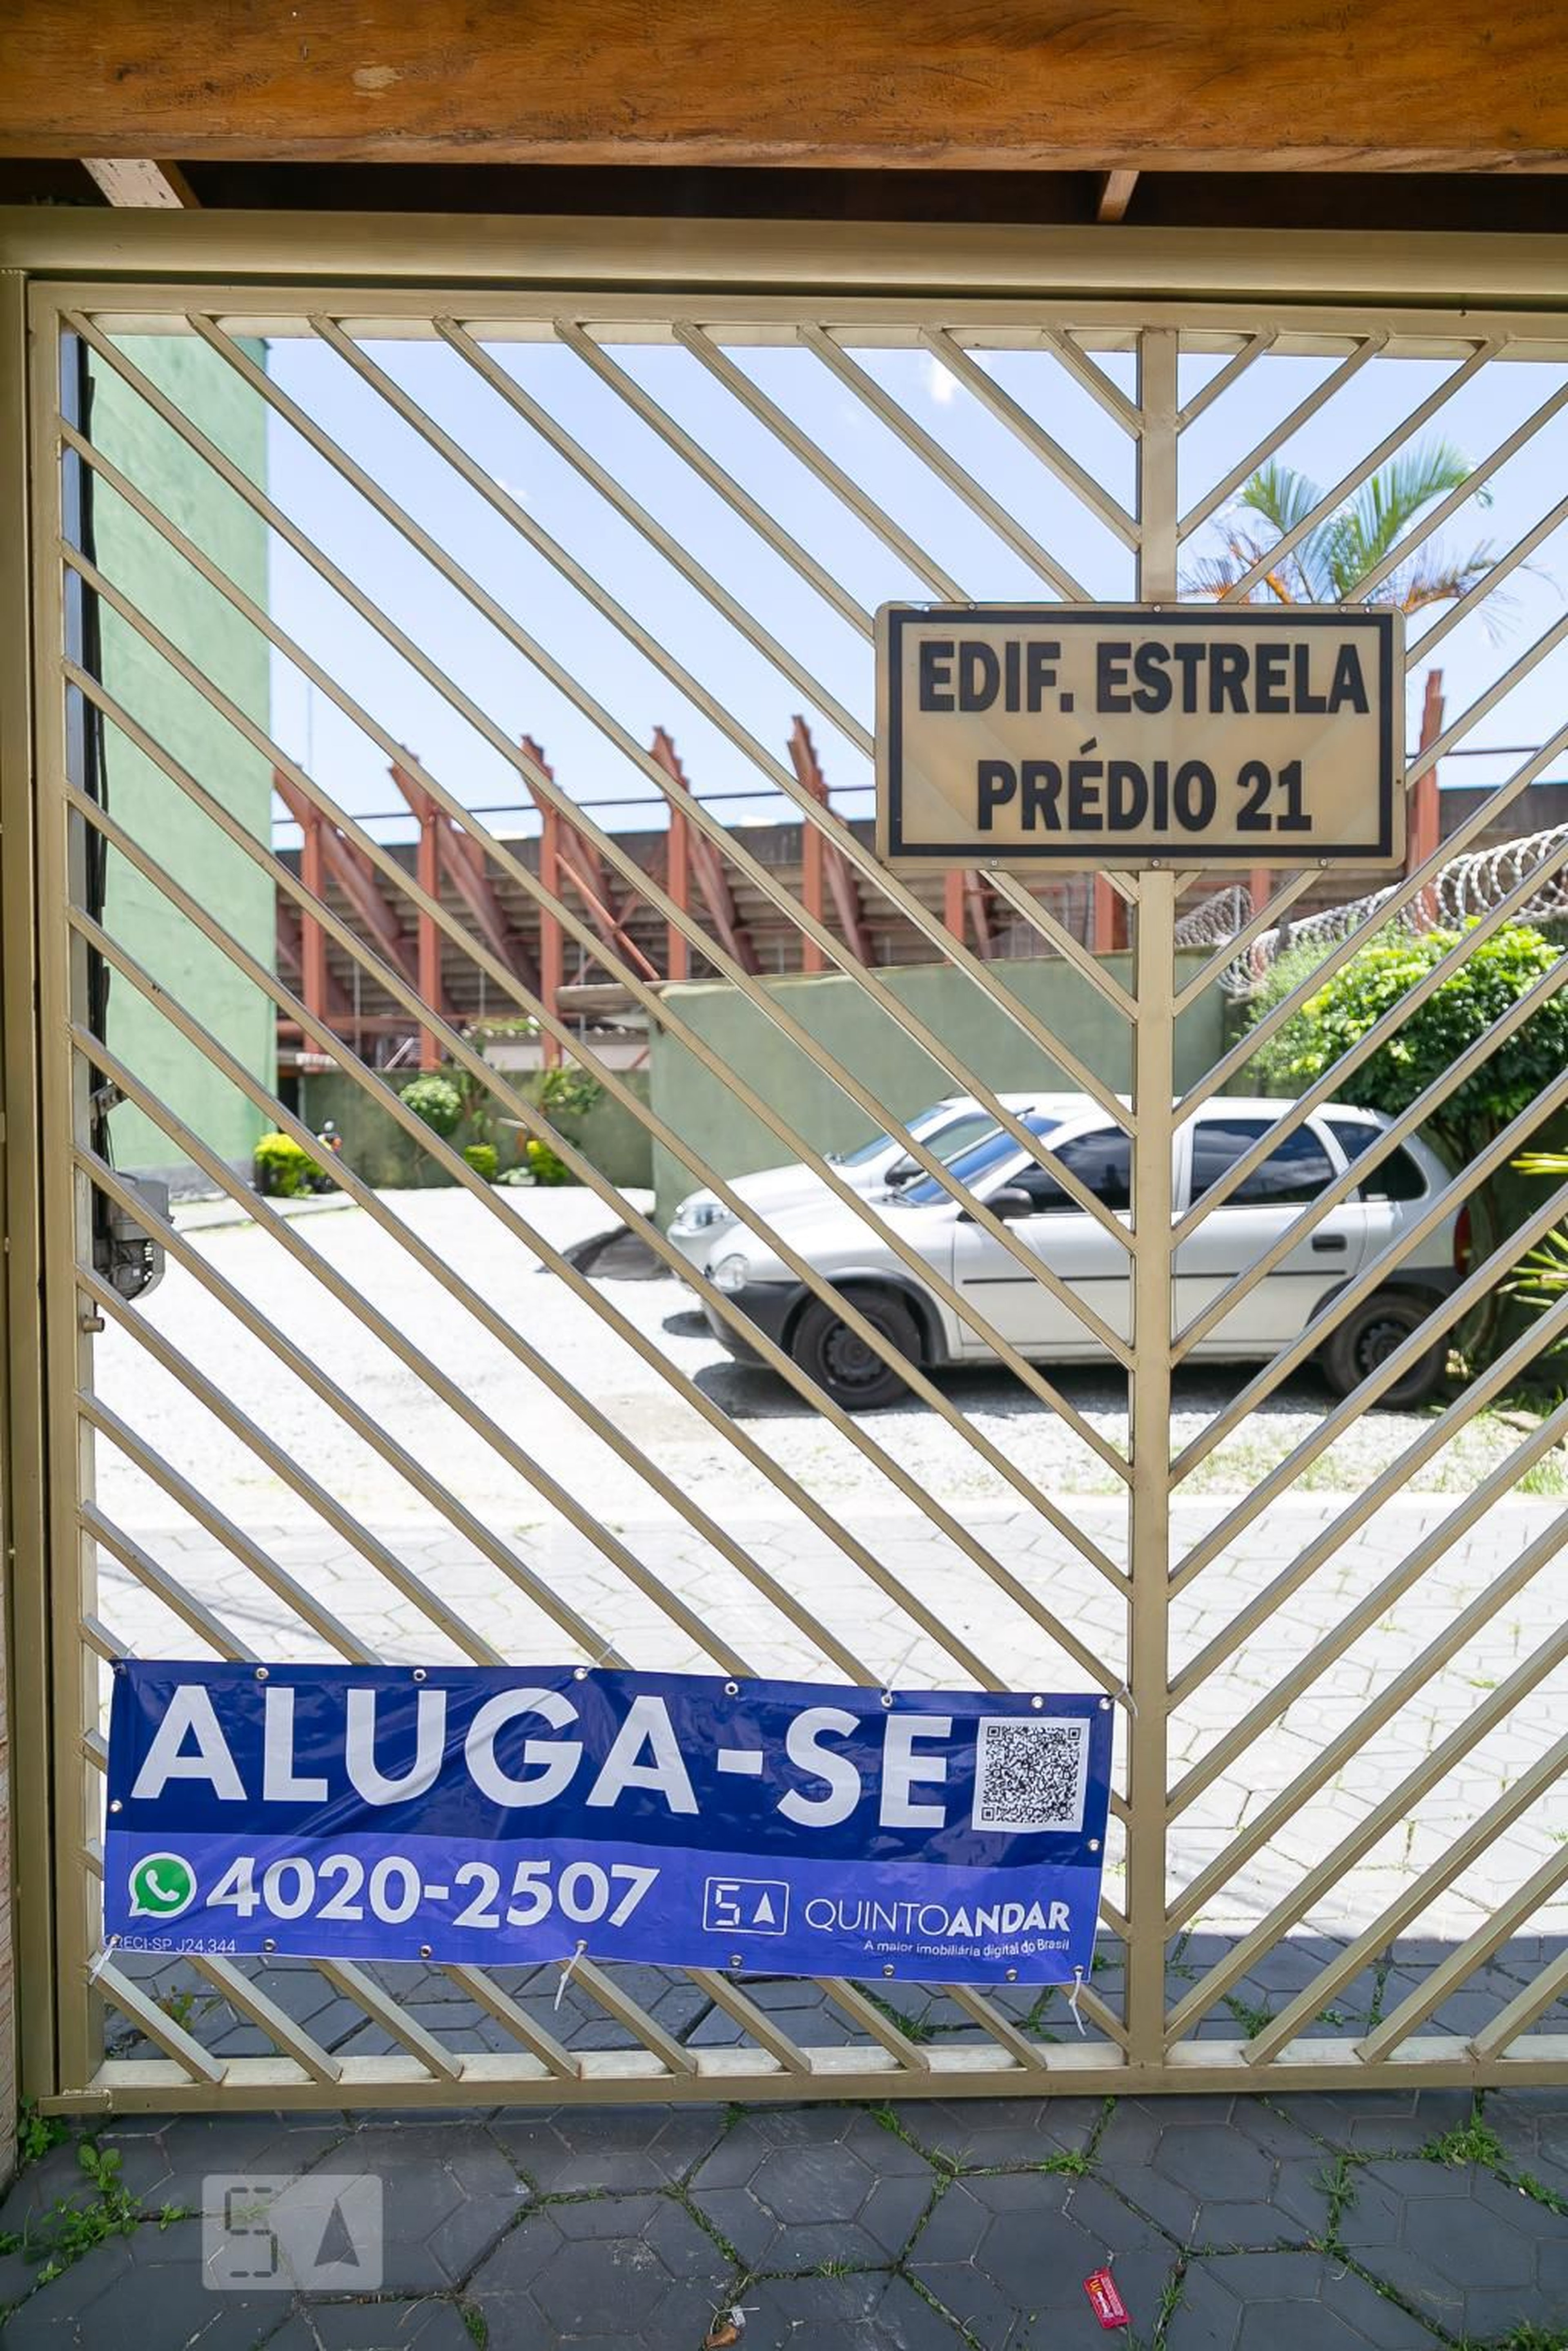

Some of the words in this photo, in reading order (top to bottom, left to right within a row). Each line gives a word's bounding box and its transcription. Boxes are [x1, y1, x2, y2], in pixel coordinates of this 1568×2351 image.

[919, 641, 1074, 713] EDIF.
[1096, 642, 1370, 714] ESTRELA
[977, 737, 1216, 832] PRÉDIO
[1236, 760, 1312, 832] 21
[130, 1684, 953, 1829] ALUGA-SE
[206, 1854, 661, 1928] 4020-2507
[805, 1898, 1070, 1938] QUINTOANDAR
[176, 1938, 236, 1953] J24.344
[863, 1940, 873, 1950] A
[877, 1942, 913, 1952] maior
[916, 1943, 980, 1956] imobiliária
[984, 1942, 1019, 1958] digital
[1021, 1940, 1036, 1953] do
[1038, 1938, 1069, 1950] Brasil
